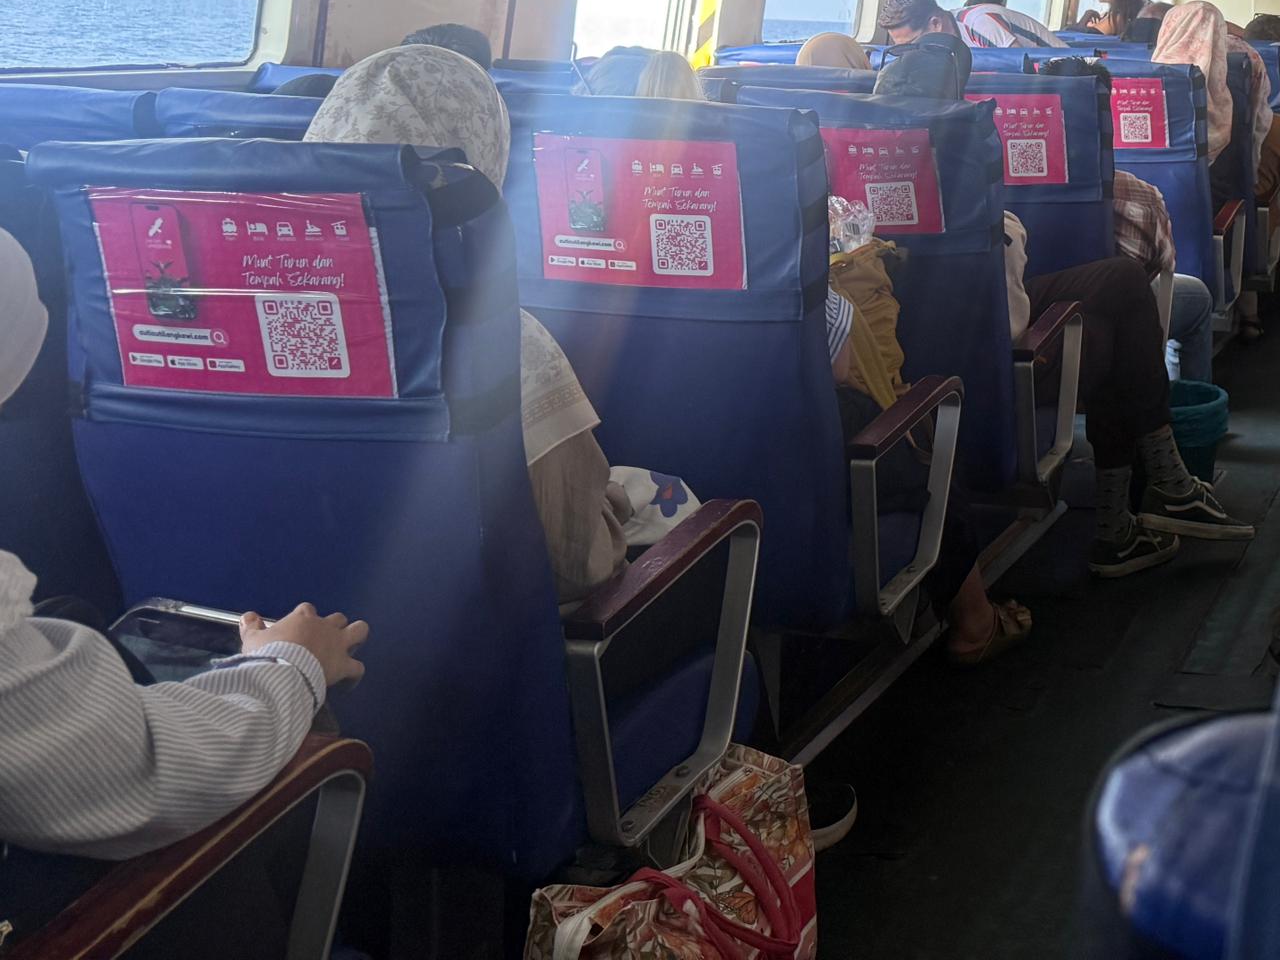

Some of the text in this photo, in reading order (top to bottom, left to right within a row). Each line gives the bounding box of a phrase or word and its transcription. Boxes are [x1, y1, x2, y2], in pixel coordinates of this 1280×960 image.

[243, 253, 334, 270] Muat Turun dan
[241, 271, 345, 289] Tempah Sekarang!
